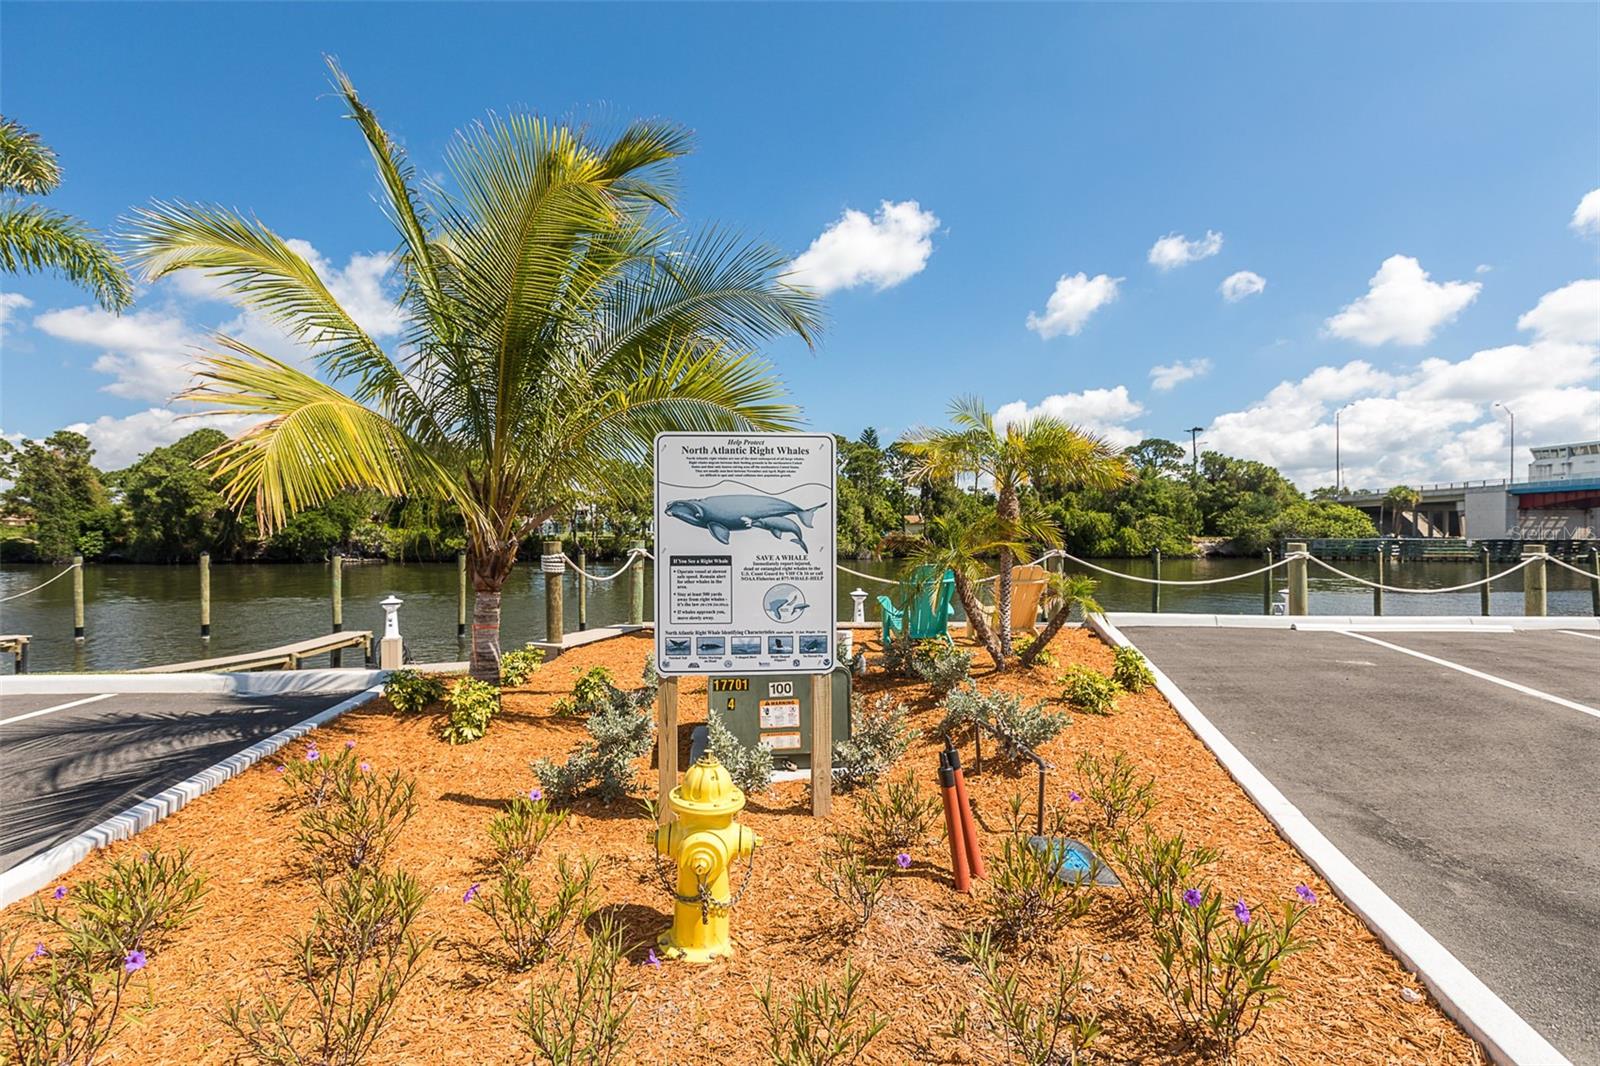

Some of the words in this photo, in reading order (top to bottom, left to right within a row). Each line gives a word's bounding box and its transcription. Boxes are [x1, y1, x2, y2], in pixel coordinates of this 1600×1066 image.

[681, 446, 709, 454] North
[711, 446, 747, 454] Atlantic
[749, 446, 775, 456] Right
[776, 447, 810, 455] Whales
[713, 679, 748, 691] 17701
[770, 683, 792, 694] 100
[728, 699, 735, 710] 4
